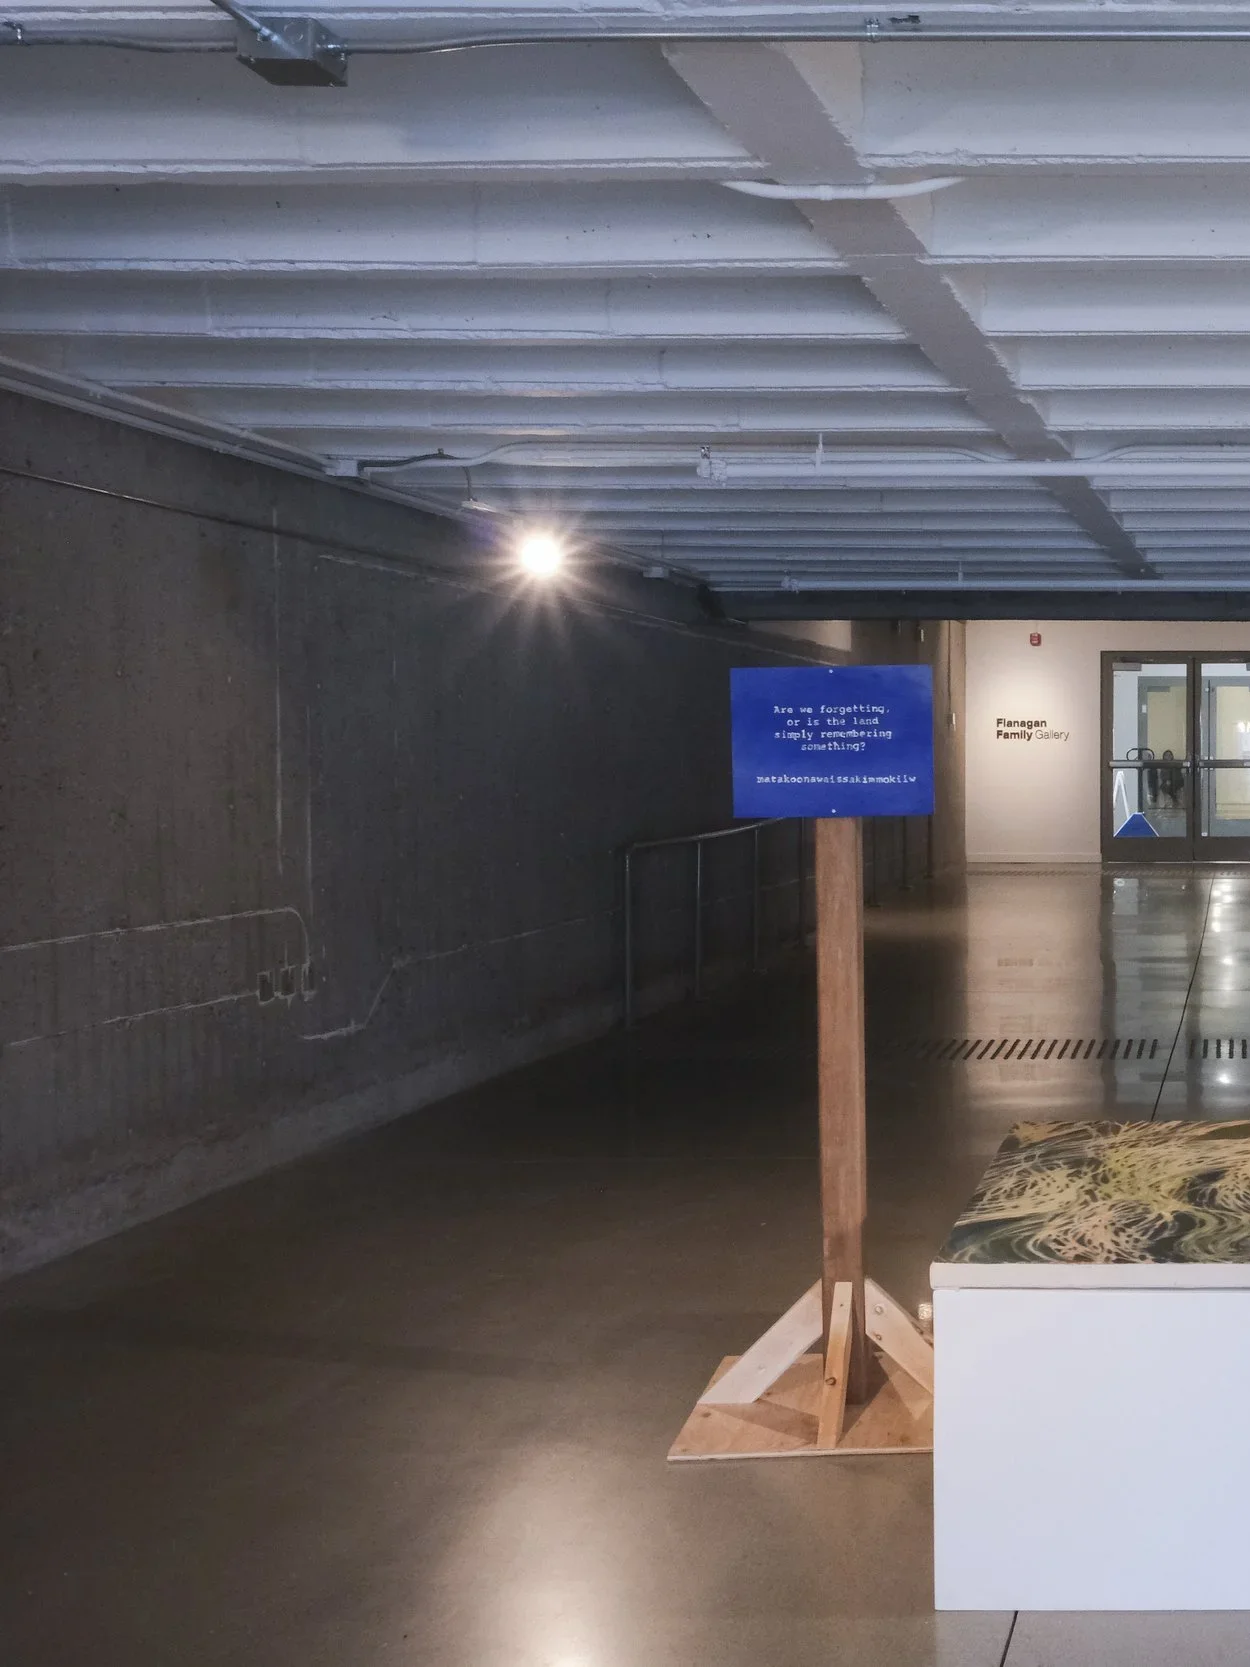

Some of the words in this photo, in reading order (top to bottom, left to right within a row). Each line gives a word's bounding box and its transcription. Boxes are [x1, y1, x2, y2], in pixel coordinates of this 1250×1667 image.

[773, 705, 794, 714] Are
[799, 706, 813, 714] we
[819, 704, 890, 715] forgetting,
[786, 718, 801, 727] or
[807, 717, 820, 727] is
[826, 716, 846, 726] the
[853, 716, 880, 726] land
[996, 717, 1047, 729] Flanagan
[774, 729, 814, 741] simply
[820, 729, 893, 740] remembering
[996, 729, 1033, 741] Family
[1034, 729, 1070, 741] Gallery
[800, 742, 866, 752] something?
